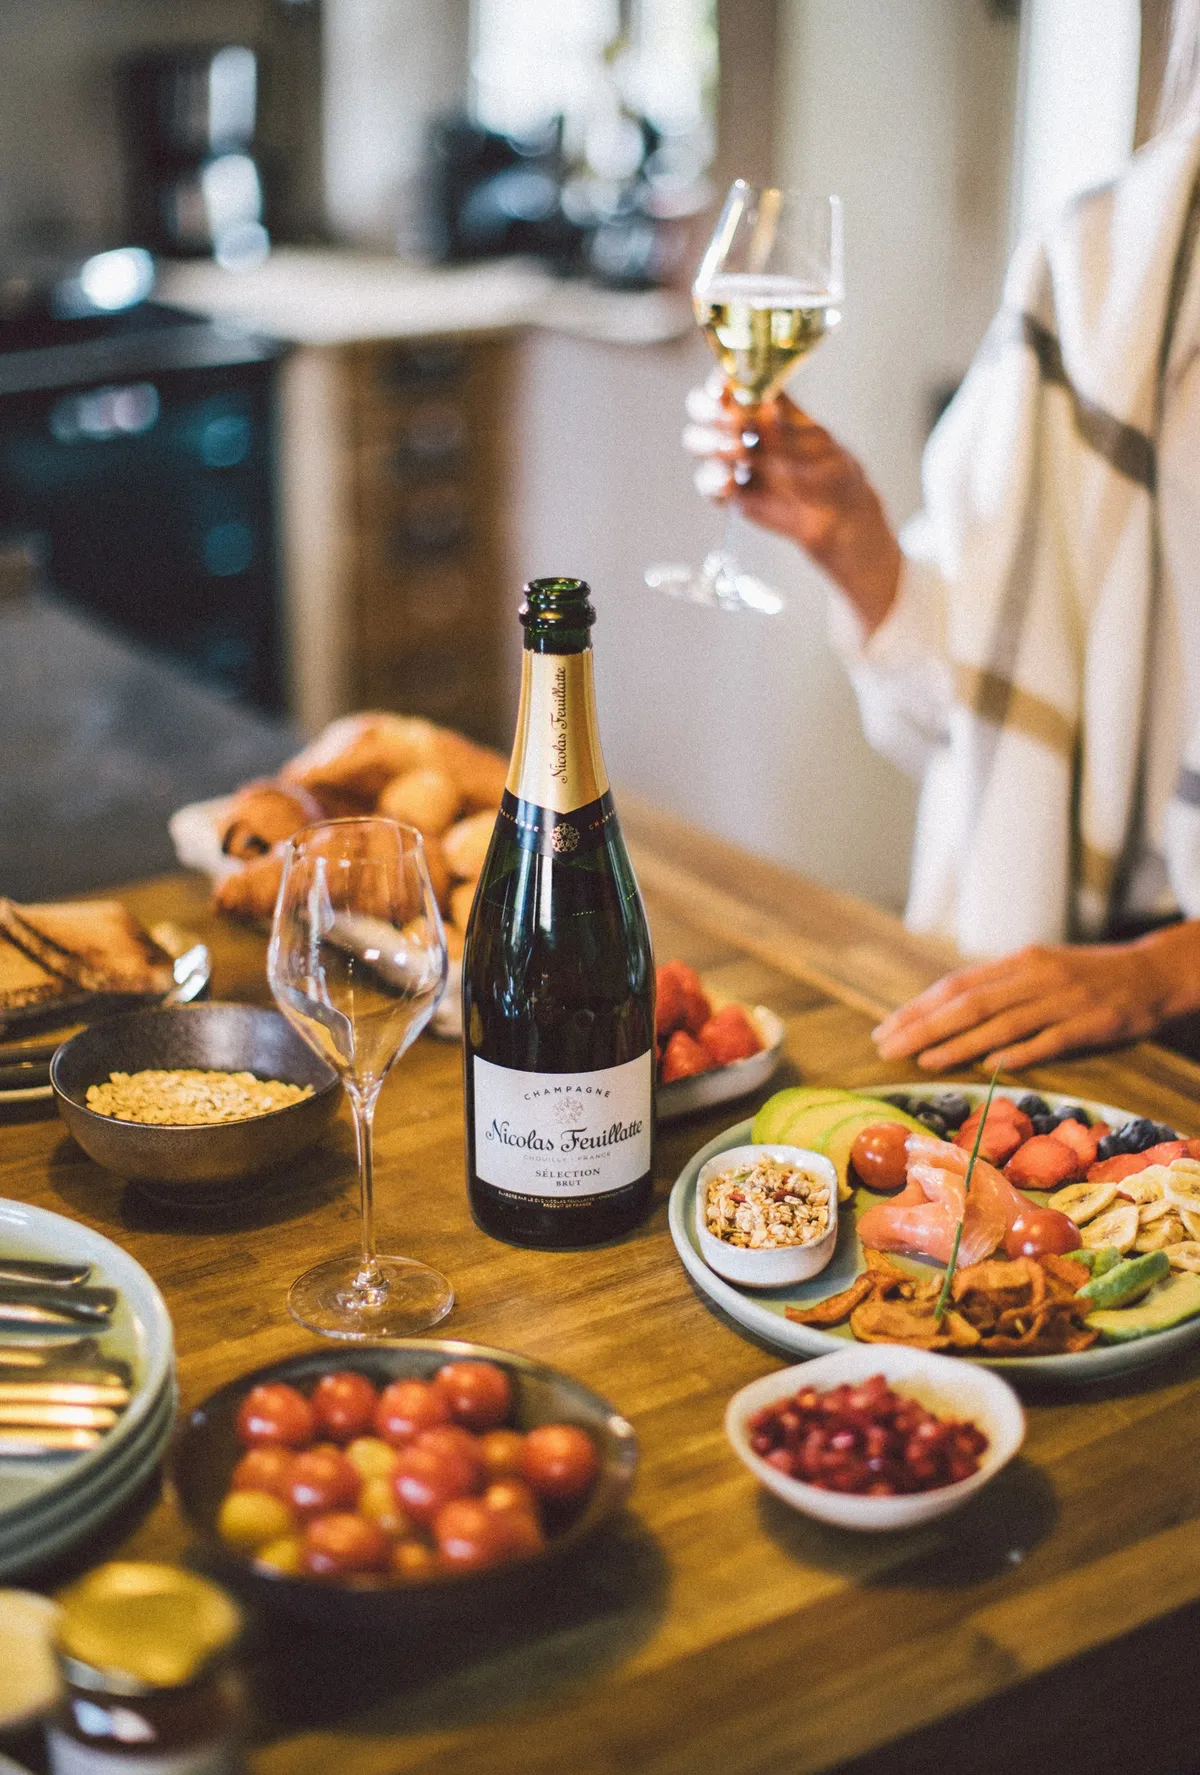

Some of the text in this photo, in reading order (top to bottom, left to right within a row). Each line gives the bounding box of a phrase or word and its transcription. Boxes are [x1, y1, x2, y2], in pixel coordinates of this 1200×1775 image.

[549, 666, 568, 784] Nicolas Feuillatte
[524, 1085, 611, 1101] CHAMPAGNE
[485, 1118, 643, 1153] Nicolas Feuillatte
[523, 1151, 611, 1164] CHOUILLY FRANCE
[535, 1167, 601, 1178] SÉLECTION
